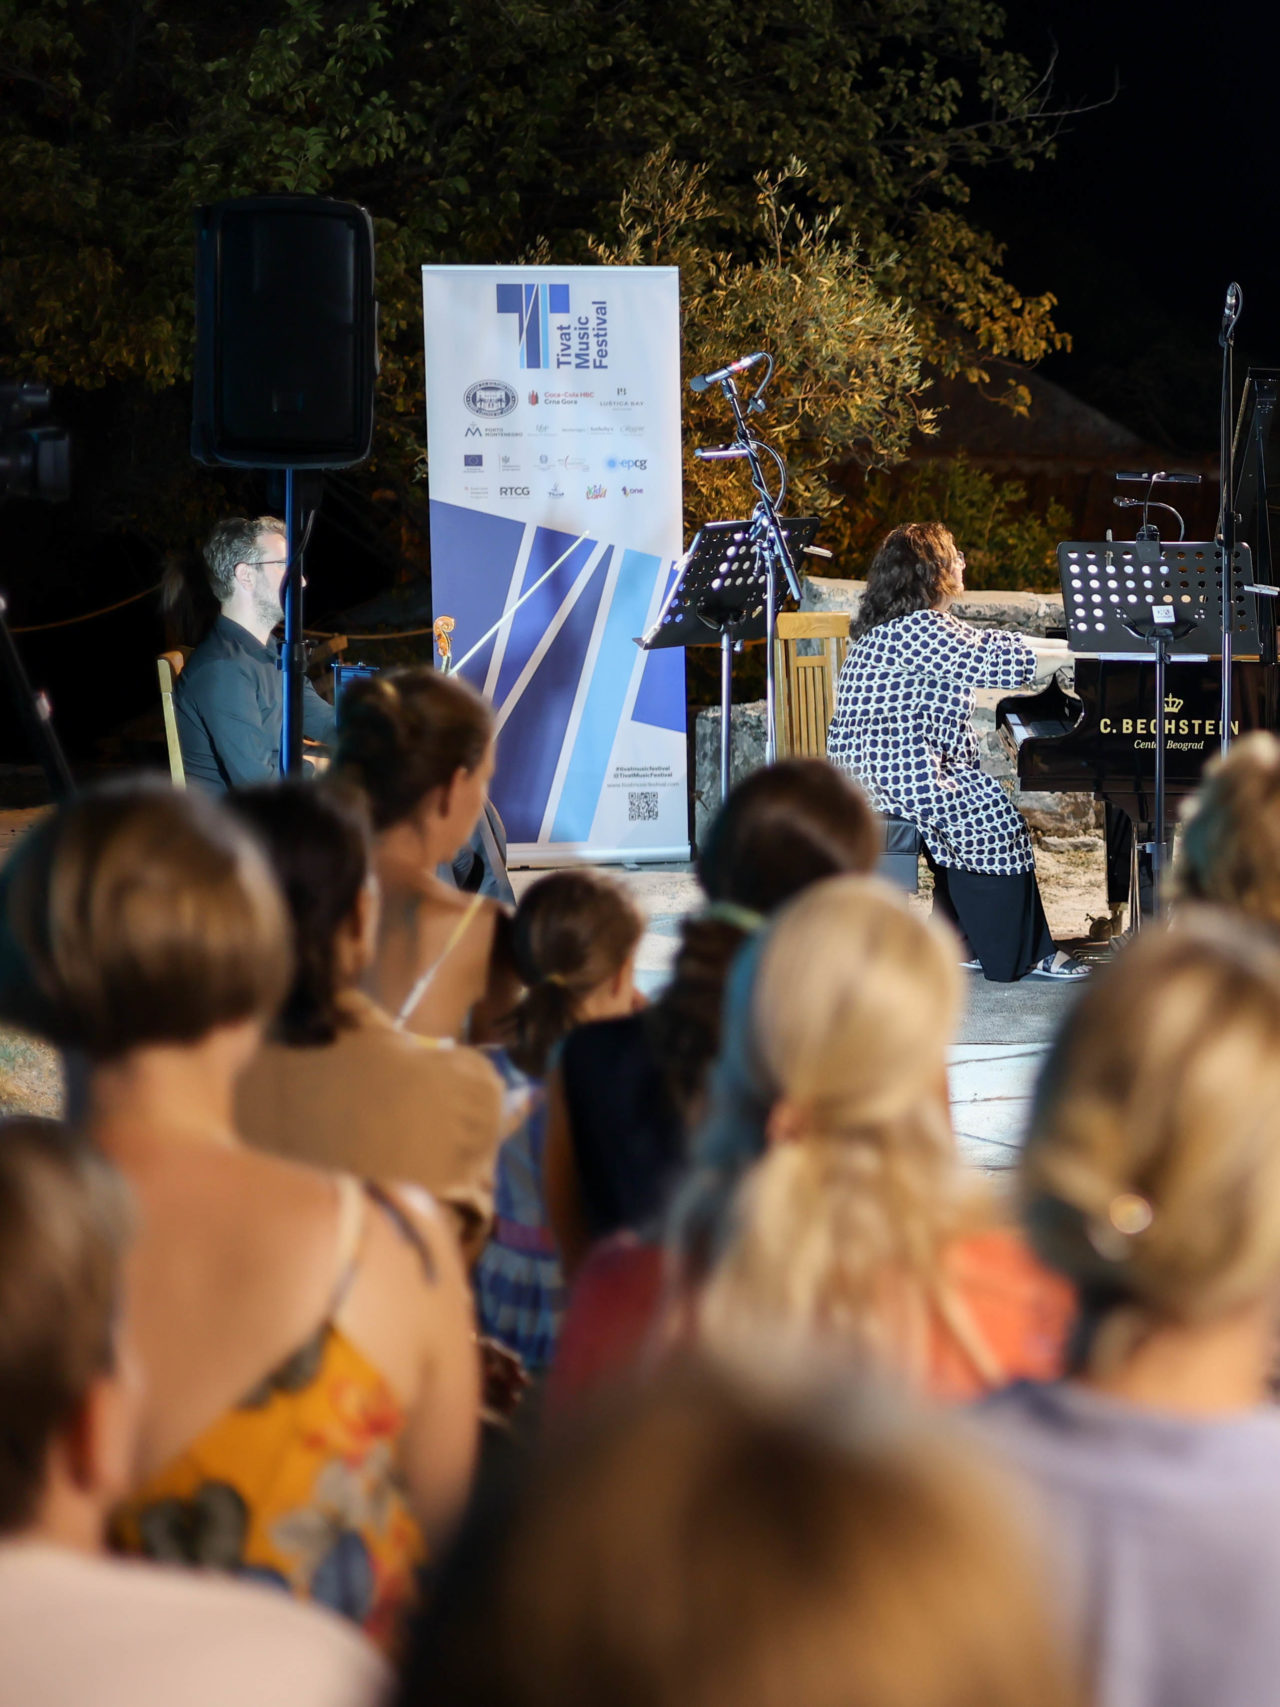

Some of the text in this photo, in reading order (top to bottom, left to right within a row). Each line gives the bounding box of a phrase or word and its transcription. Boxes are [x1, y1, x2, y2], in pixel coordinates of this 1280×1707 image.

[556, 324, 572, 369] Tivat
[574, 316, 590, 369] Music
[591, 300, 608, 369] Festival
[499, 487, 530, 496] RTCG
[1100, 718, 1117, 734] C.
[1166, 740, 1204, 751] Beograd
